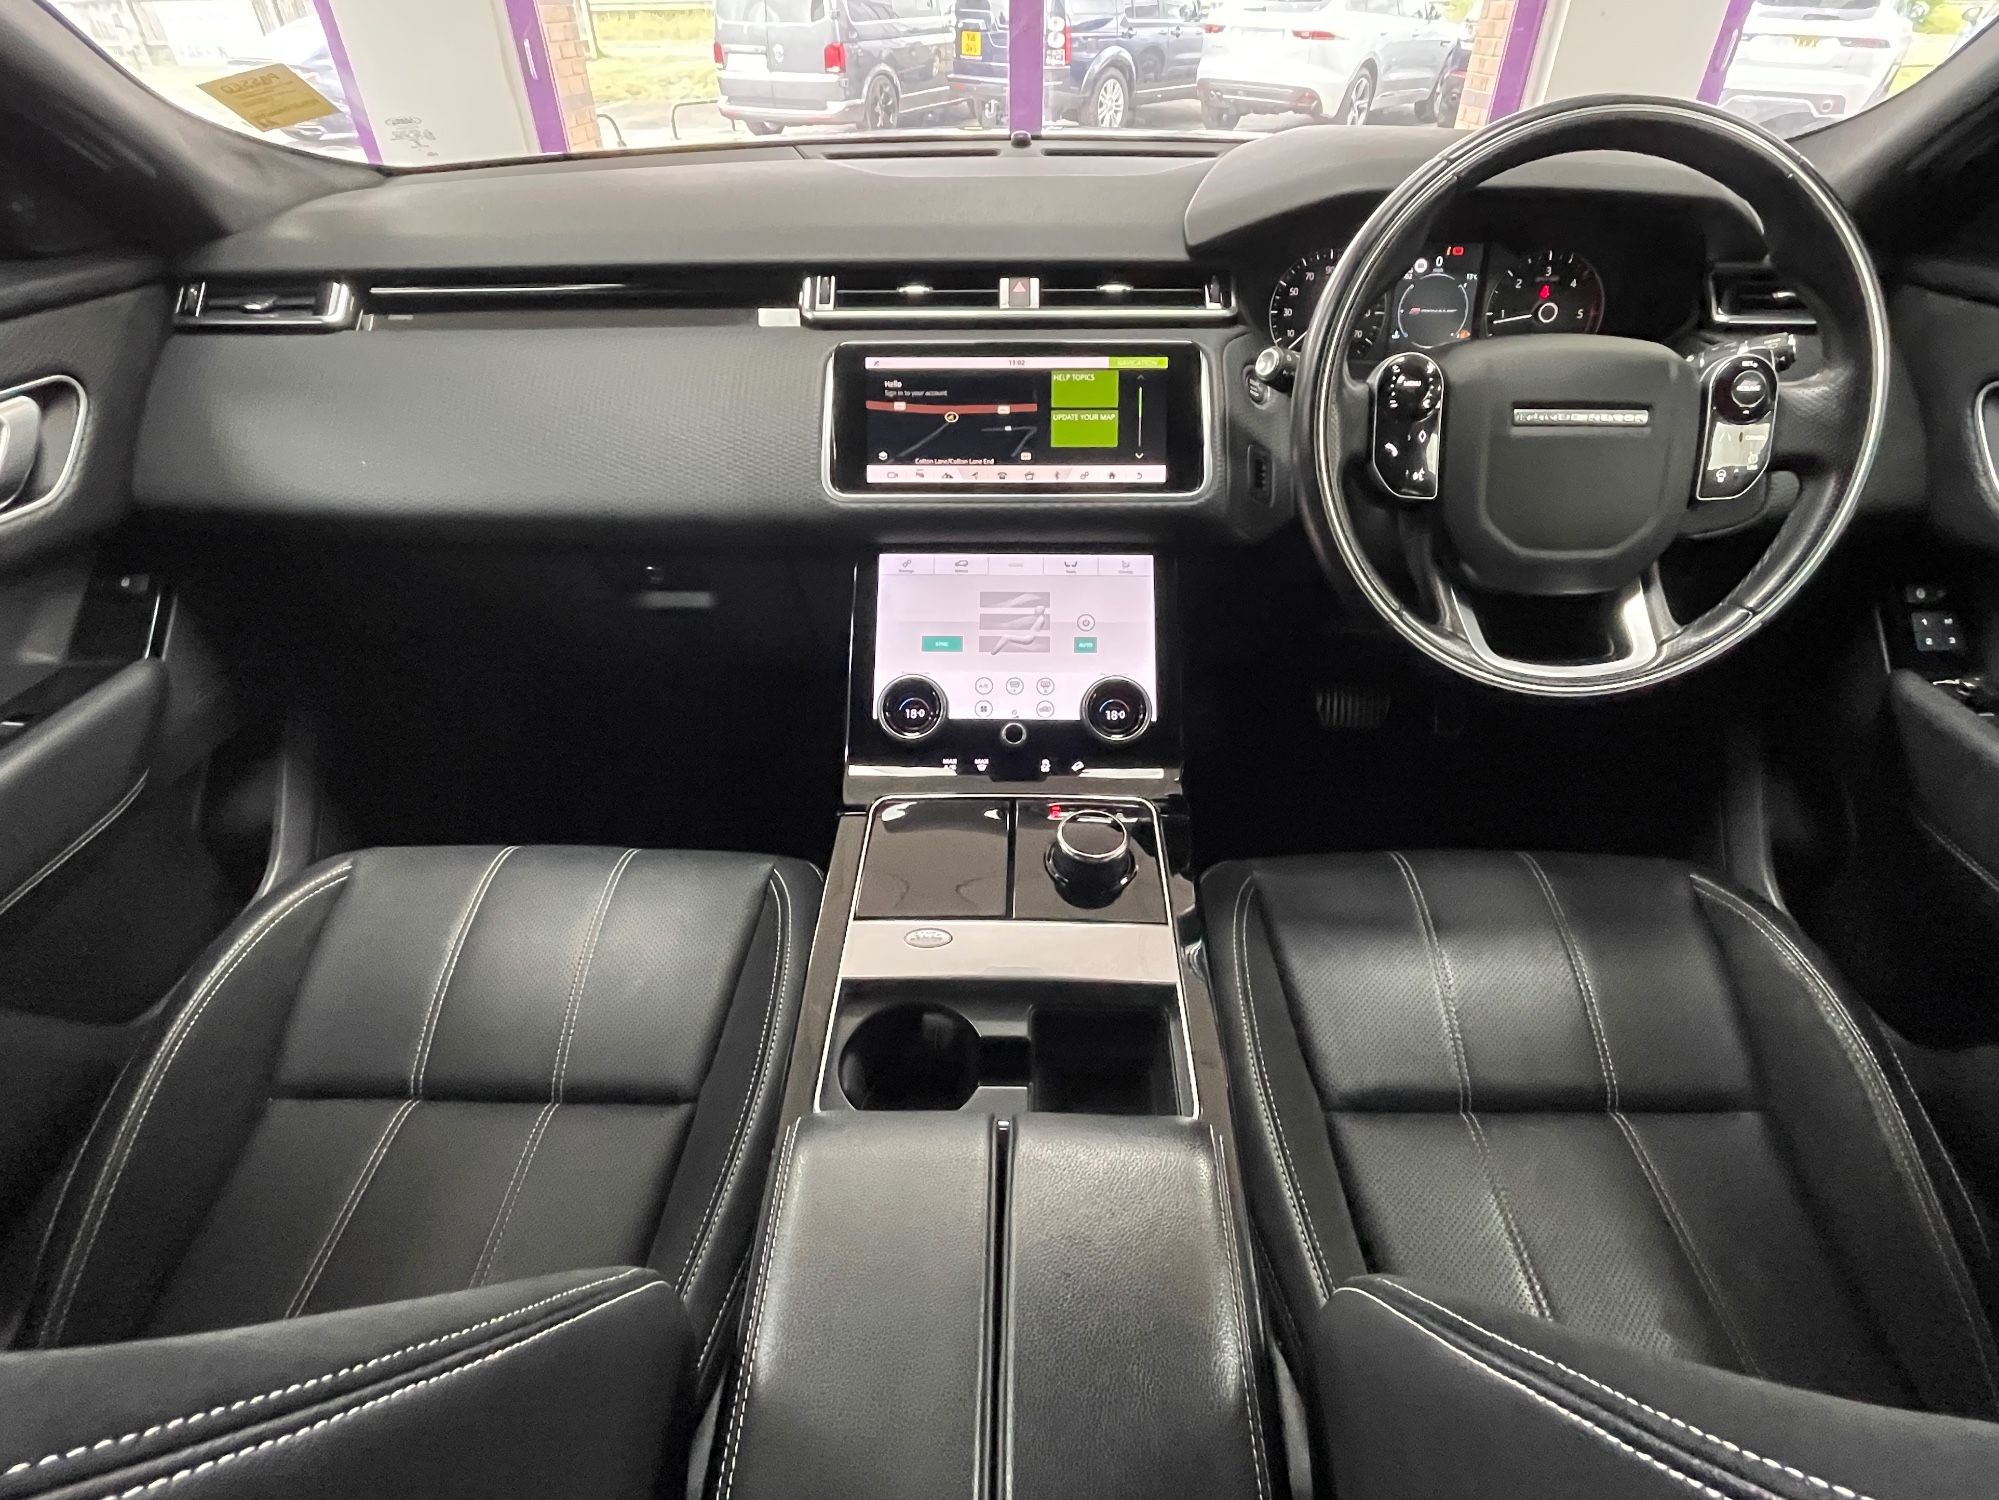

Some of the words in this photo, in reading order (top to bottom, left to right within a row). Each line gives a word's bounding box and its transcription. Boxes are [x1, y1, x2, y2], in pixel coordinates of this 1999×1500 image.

[1436, 255, 1444, 267] 0
[1545, 266, 1552, 276] 3
[1305, 272, 1315, 280] 70
[1515, 278, 1523, 288] 2
[1570, 278, 1577, 288] 4
[1289, 287, 1299, 296] 50
[1283, 308, 1293, 317] 30
[1501, 309, 1505, 318] 1
[1576, 308, 1584, 319] 5
[1286, 329, 1295, 337] 10
[1053, 373, 1070, 381] HELP
[1072, 374, 1095, 382] TOPICS
[884, 379, 903, 388] Hello
[884, 389, 897, 398] Sign
[1053, 413, 1078, 421] UPDATE
[1080, 413, 1099, 421] YOUR
[1100, 413, 1116, 421] MAP
